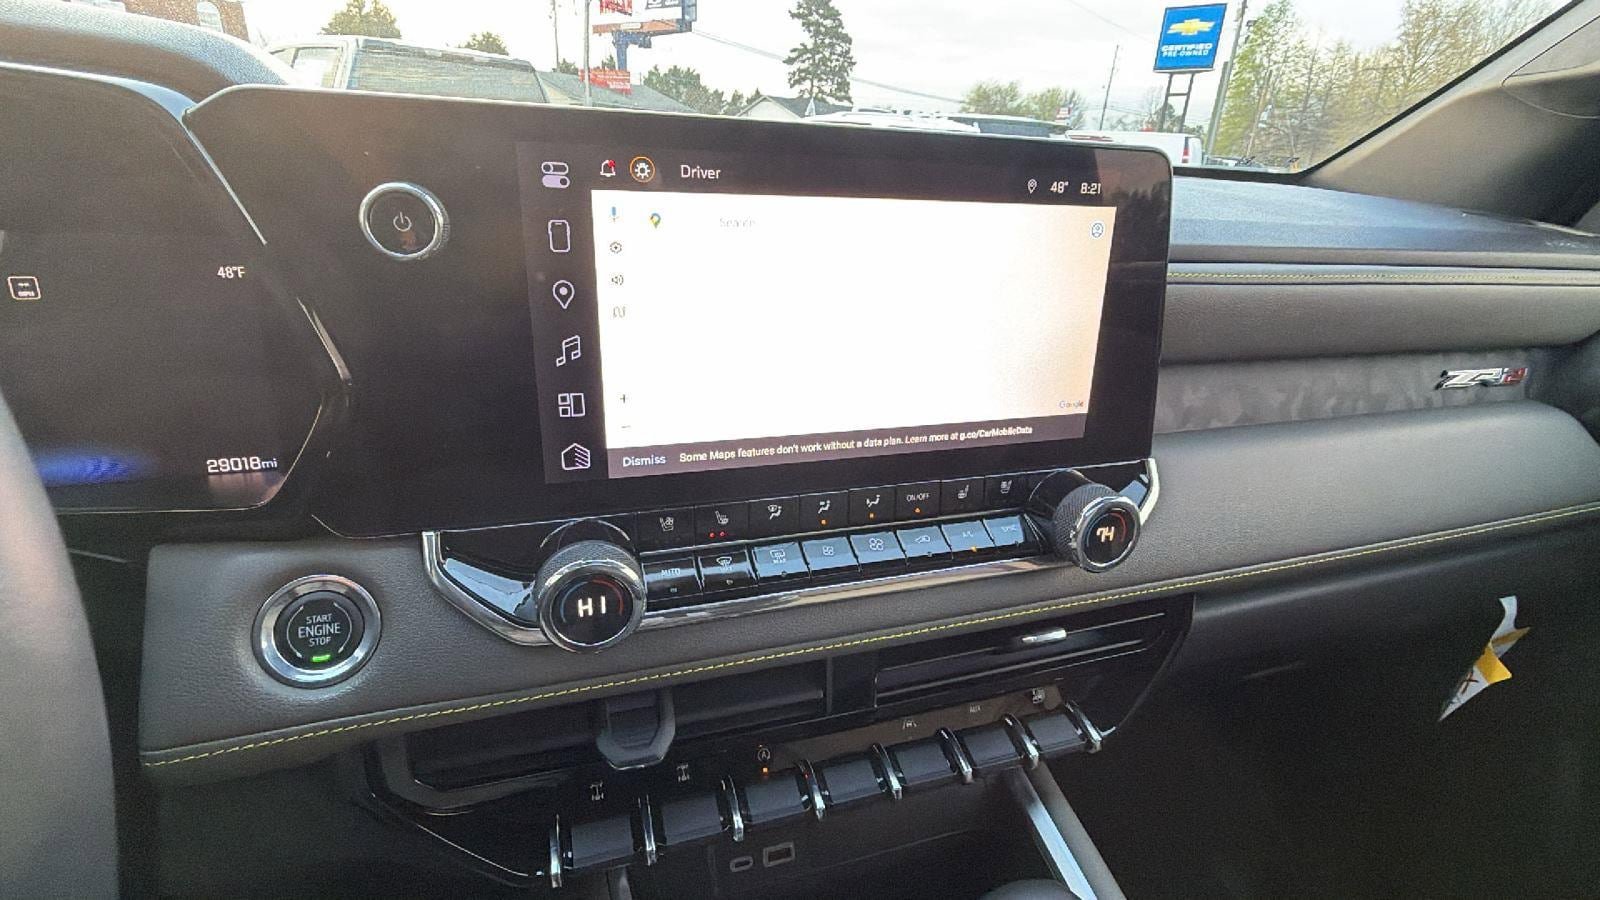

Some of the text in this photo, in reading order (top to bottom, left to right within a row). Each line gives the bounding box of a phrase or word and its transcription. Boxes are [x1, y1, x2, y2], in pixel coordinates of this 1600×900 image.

[1161, 43, 1213, 52] CERTIFIED
[680, 164, 721, 179] Driver
[1080, 182, 1102, 195] 8:21
[217, 266, 246, 279] 48°F
[1435, 367, 1528, 390] ZR2
[679, 426, 1033, 463] Some Maps features don't work without a data plan. Learn more at g.co/CarMobileData
[622, 454, 667, 468] Dismiss
[906, 493, 930, 502] ON/OFF
[661, 568, 681, 577] AUTO
[306, 613, 332, 624] START
[298, 622, 340, 638] ENGINE
[309, 636, 331, 647] STOP
